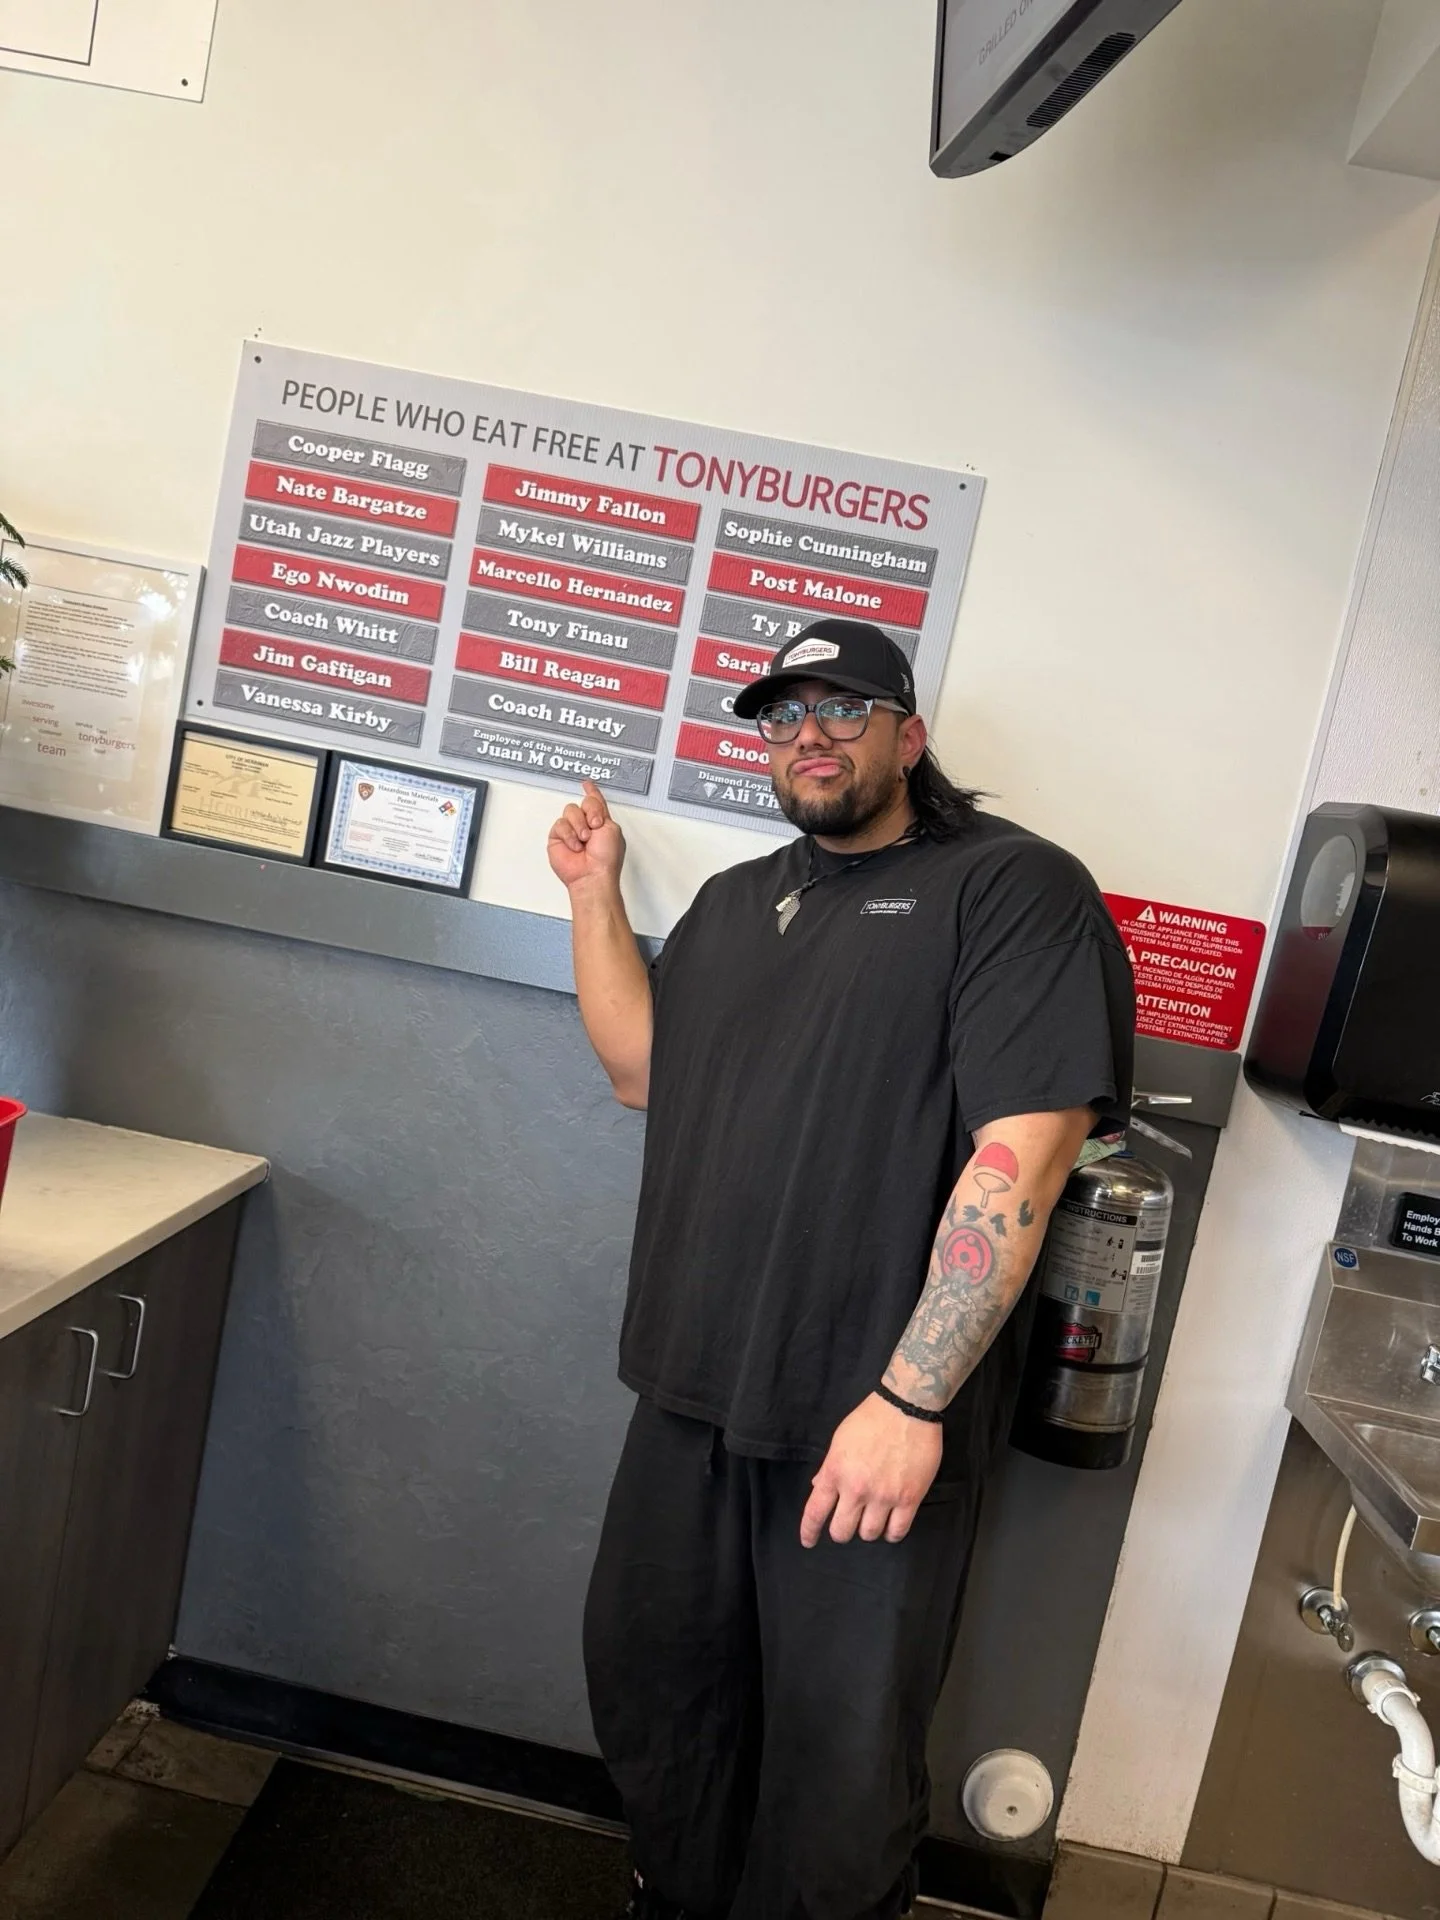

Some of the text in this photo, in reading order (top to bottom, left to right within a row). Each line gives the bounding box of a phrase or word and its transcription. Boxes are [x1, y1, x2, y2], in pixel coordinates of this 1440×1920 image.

[282, 379, 931, 531] PEOPLE WHO EAT FREE AT TONYBURGERS
[288, 435, 430, 481] Cooper Flagg
[276, 474, 428, 520] Nate Bargatze
[515, 480, 666, 525] Jimmy Fallon
[249, 513, 440, 567] Utah Jazz Players
[498, 519, 668, 569] Mykel Williams
[724, 521, 927, 574] Sophie Cunningham
[271, 562, 410, 605] Ego Nwodim
[477, 559, 673, 613] Marcello Hernández
[748, 568, 883, 609] Post Malone
[264, 602, 399, 644] Coach Whitt
[507, 609, 629, 650] Tony Finau
[752, 613, 805, 638] Ty B
[253, 645, 392, 688] Jim Gaffigan
[499, 651, 621, 691] Bill Reagan
[241, 684, 393, 732] Vanessa Kirby
[488, 693, 627, 738] Coach Hardy
[37, 742, 66, 757] team
[78, 732, 136, 750] tonyburgers
[473, 729, 521, 745] Employee
[523, 740, 534, 749] of
[536, 742, 552, 752] the
[554, 745, 586, 759] Month
[593, 754, 621, 766] April
[477, 741, 612, 780] Juan M Ortega
[698, 771, 775, 794] Diamond Loyal
[411, 791, 439, 803] Materials
[721, 786, 781, 809] Ali Th
[1130, 920, 1146, 929] CASE
[1157, 926, 1192, 938] APPLIANCE
[1225, 938, 1240, 947] THIS
[1159, 911, 1228, 934] WARNING
[1131, 935, 1157, 945] SYSTEM
[1157, 939, 1170, 947] HAS
[1171, 942, 1189, 951] BEEN
[1161, 934, 1182, 942] AFTER
[1182, 937, 1202, 946] FIXED
[1137, 971, 1153, 980] ESTE
[1153, 975, 1184, 986] EXTINTOR
[1140, 950, 1237, 980] PRECAUCIÓN
[1142, 966, 1172, 976] INCENDIO
[1136, 993, 1211, 1018] ATTENTION
[1146, 1010, 1185, 1022] IMPLIQUANT
[1154, 1018, 1167, 1026] CET
[1167, 1021, 1206, 1034] EXTINCTEUR
[1066, 1203, 1128, 1224] INSTRUCTIONS
[1401, 1232, 1438, 1247] To Work
[1403, 1221, 1432, 1235] Hands
[1336, 1251, 1354, 1263] NSF
